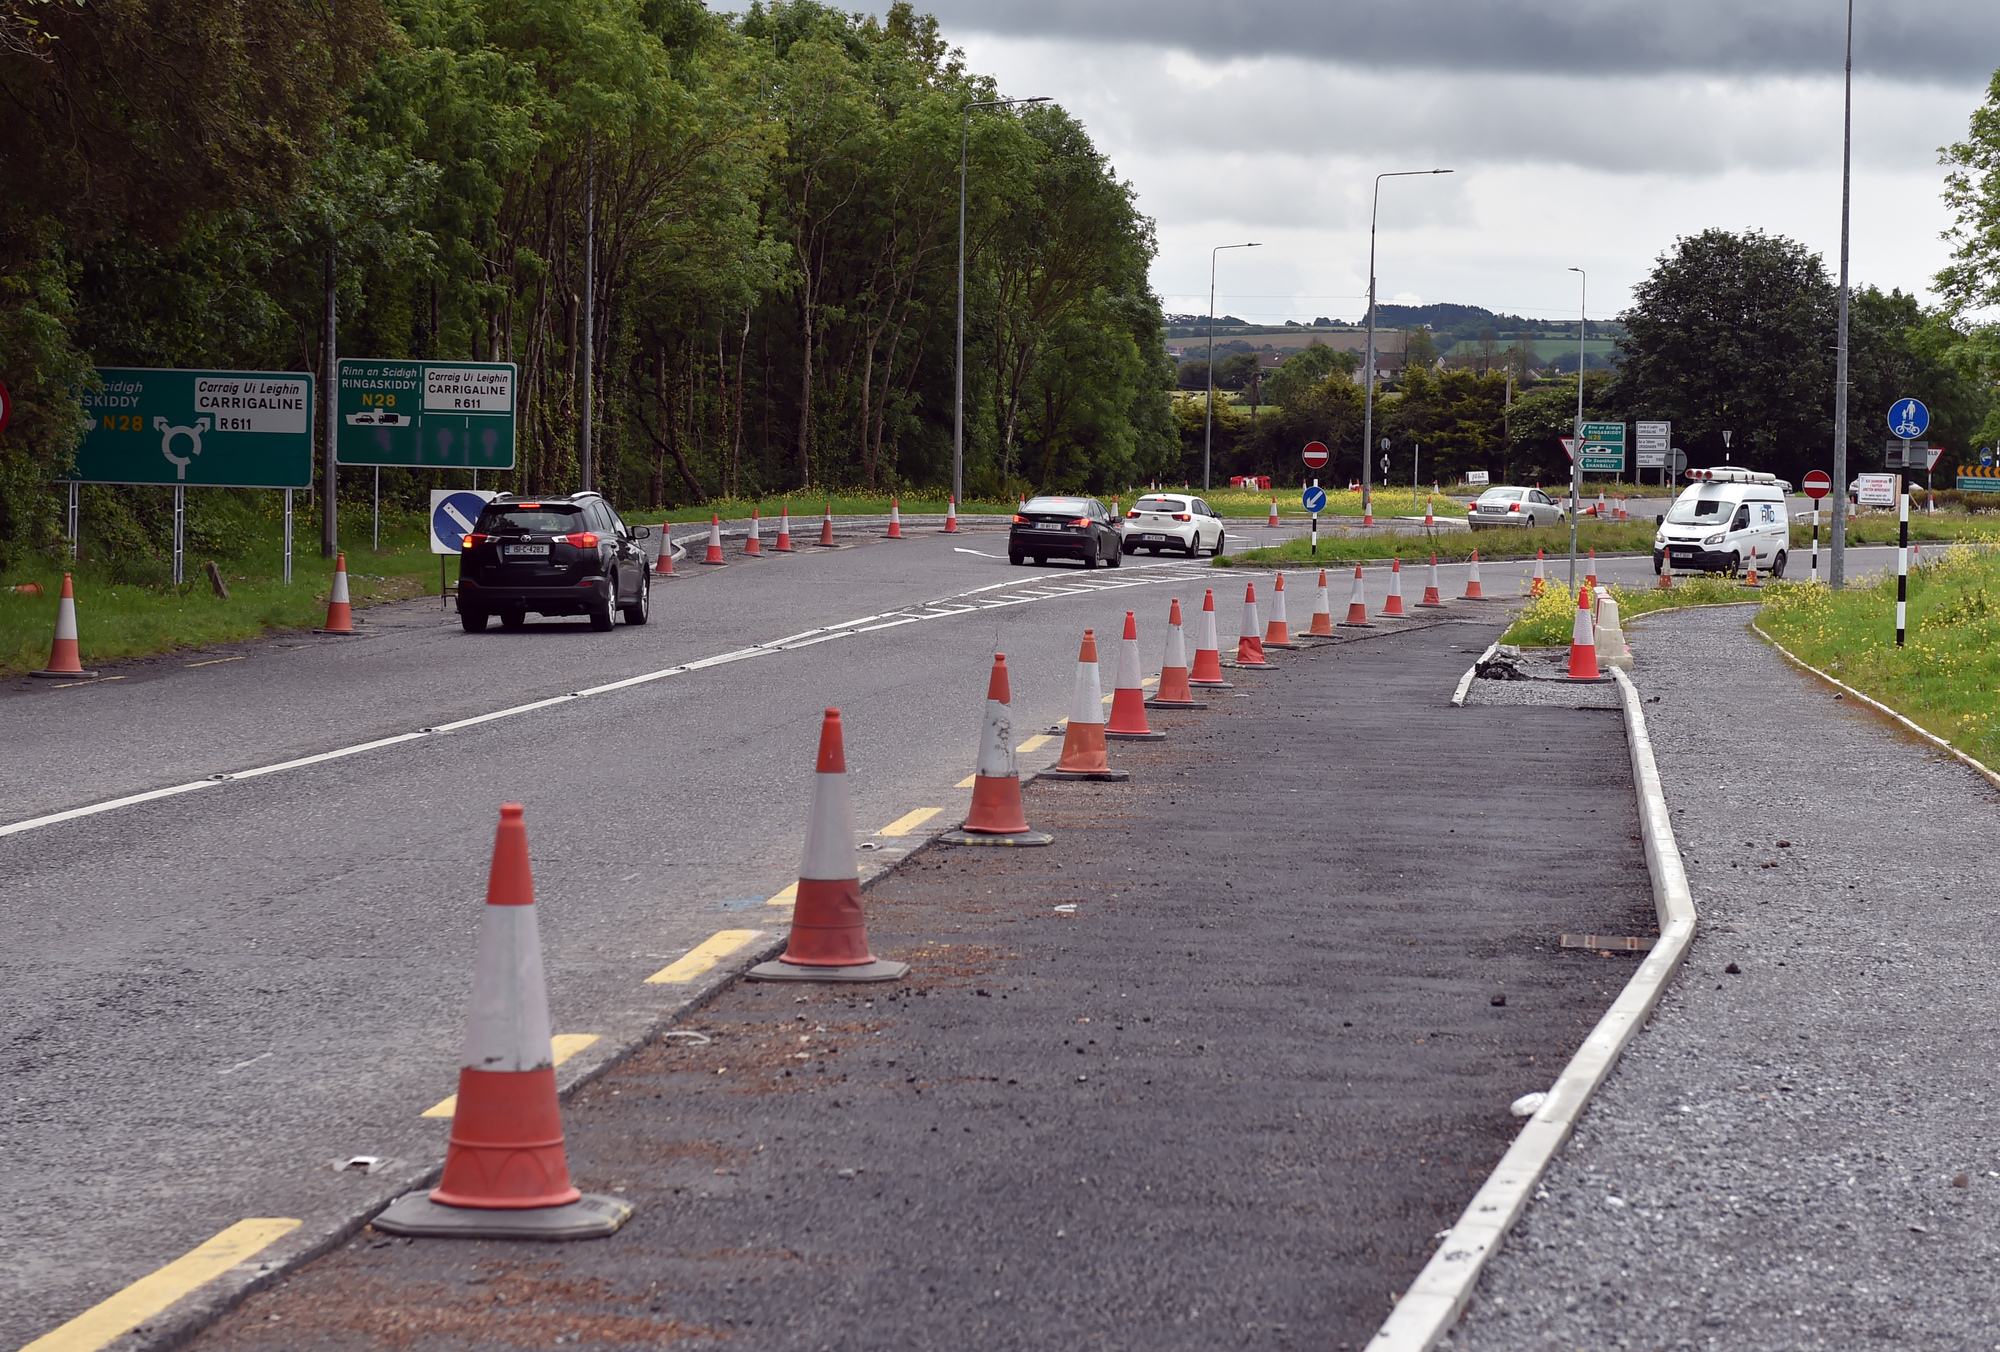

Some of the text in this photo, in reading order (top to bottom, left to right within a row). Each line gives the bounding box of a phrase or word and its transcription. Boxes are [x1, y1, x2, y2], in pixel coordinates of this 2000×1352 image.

[342, 366, 364, 376] Rinn
[342, 379, 417, 390] RINGASKIDDY
[428, 372, 461, 383] Carraig
[476, 373, 508, 384] Leighin
[199, 381, 239, 395] Carraig
[260, 383, 300, 396] Leighin
[428, 384, 506, 395] CARRIGALINE
[200, 396, 303, 410] CARRIGALINE
[362, 393, 396, 407] N28
[103, 415, 143, 431] N28
